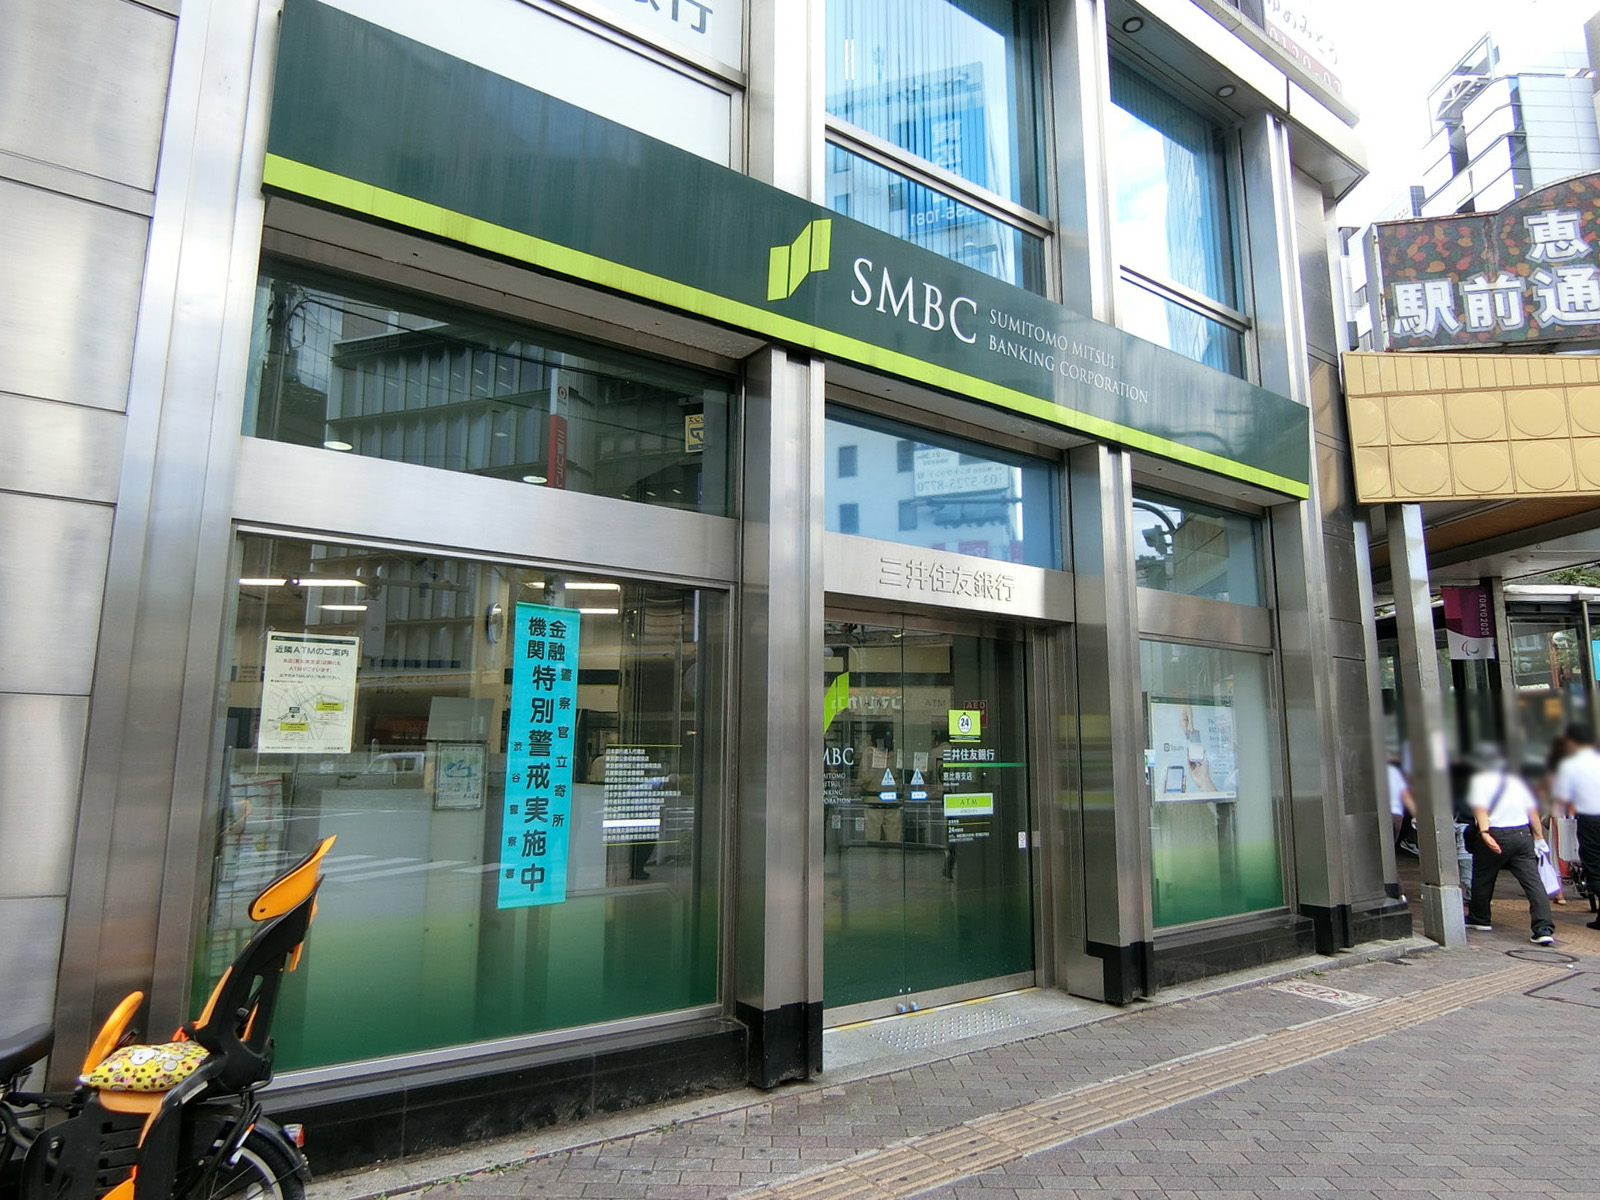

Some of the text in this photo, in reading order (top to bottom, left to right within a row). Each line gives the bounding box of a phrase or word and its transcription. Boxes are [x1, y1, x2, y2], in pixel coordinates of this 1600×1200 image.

[1525, 210, 1591, 260] 恵
[851, 257, 977, 344] SMBC
[1391, 266, 1600, 336] 駅前通
[989, 309, 1115, 369] SUMITOMO MITSUI
[988, 335, 1148, 404] BANKING CORPORATION
[879, 557, 1015, 601] 三井住友銀行
[275, 645, 350, 657] 近隣ATMのご案内
[960, 717, 970, 727] 24
[520, 664, 557, 892] 特別警戒実施中
[943, 748, 995, 761] 三井住友銀行
[960, 798, 978, 806] ATM
